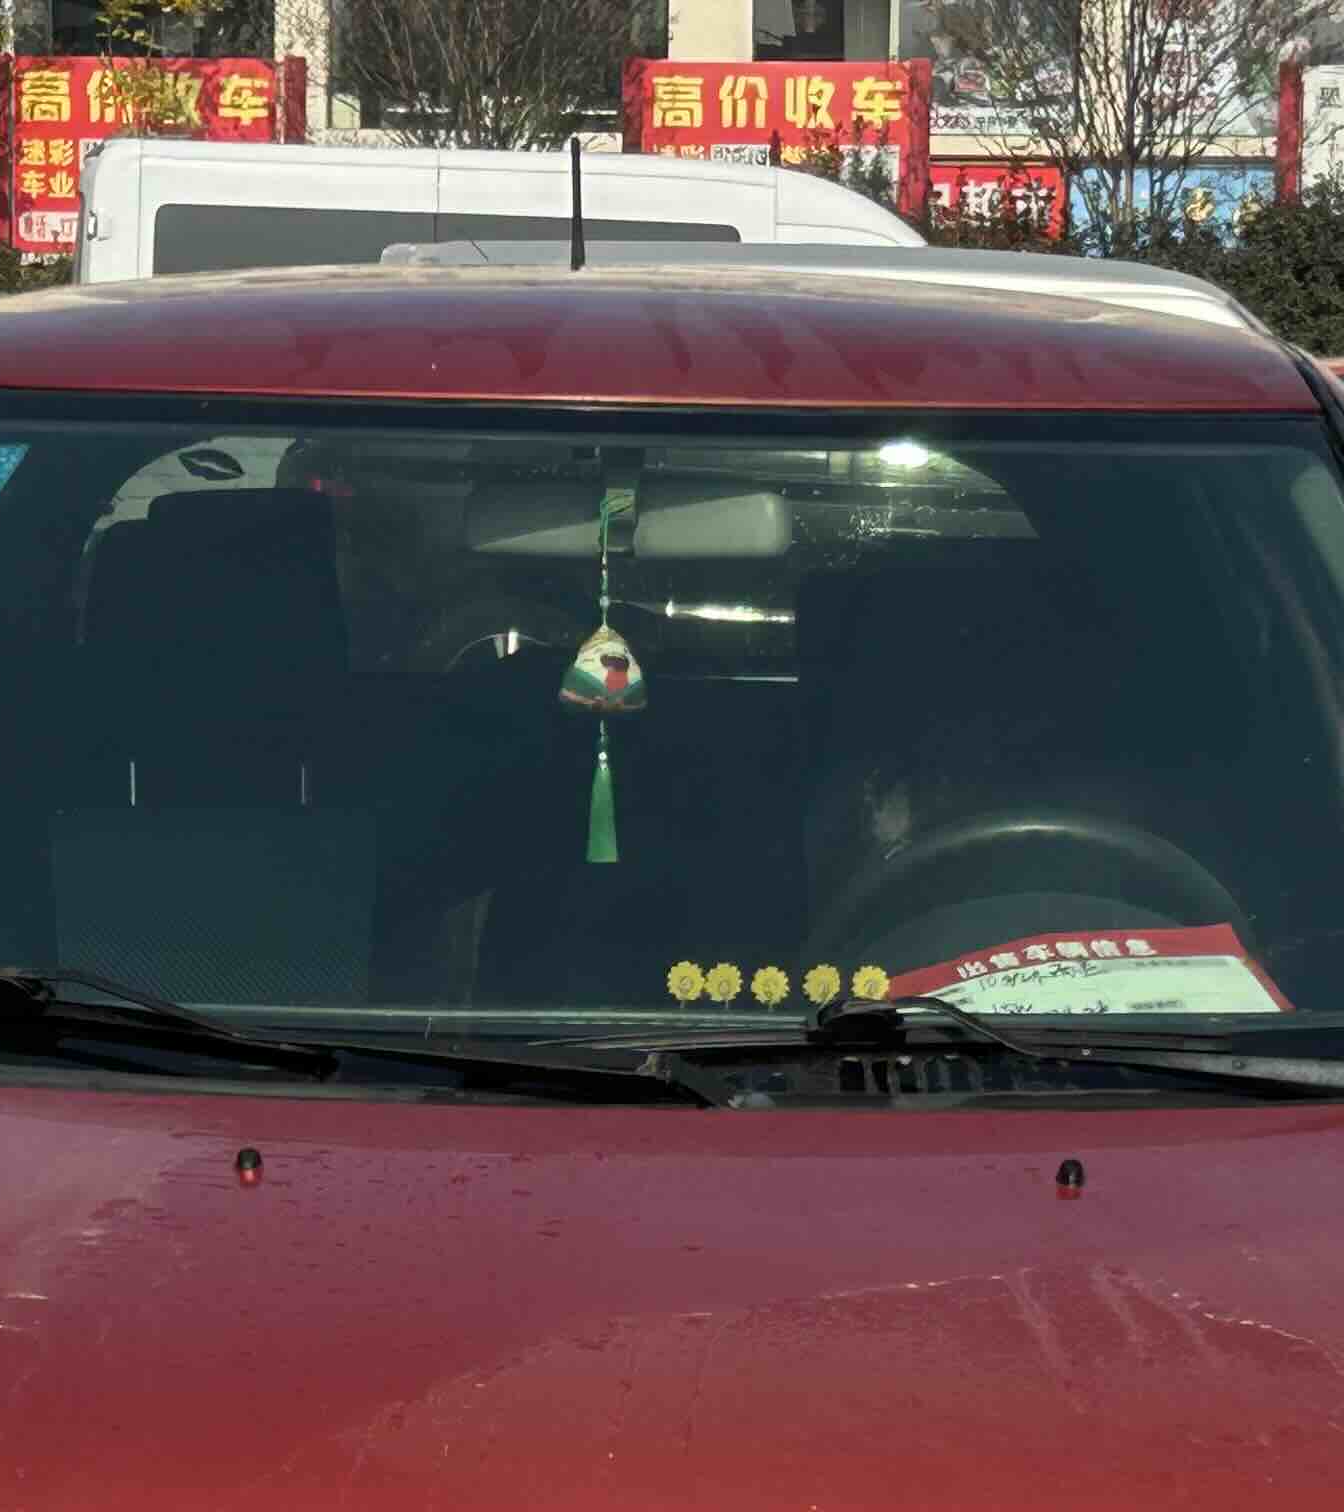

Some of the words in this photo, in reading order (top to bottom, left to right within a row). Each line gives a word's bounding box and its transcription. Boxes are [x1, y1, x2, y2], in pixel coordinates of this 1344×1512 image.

[651, 74, 904, 128] 高价收车
[18, 138, 74, 166] 迷彩
[21, 169, 76, 198] 车业
